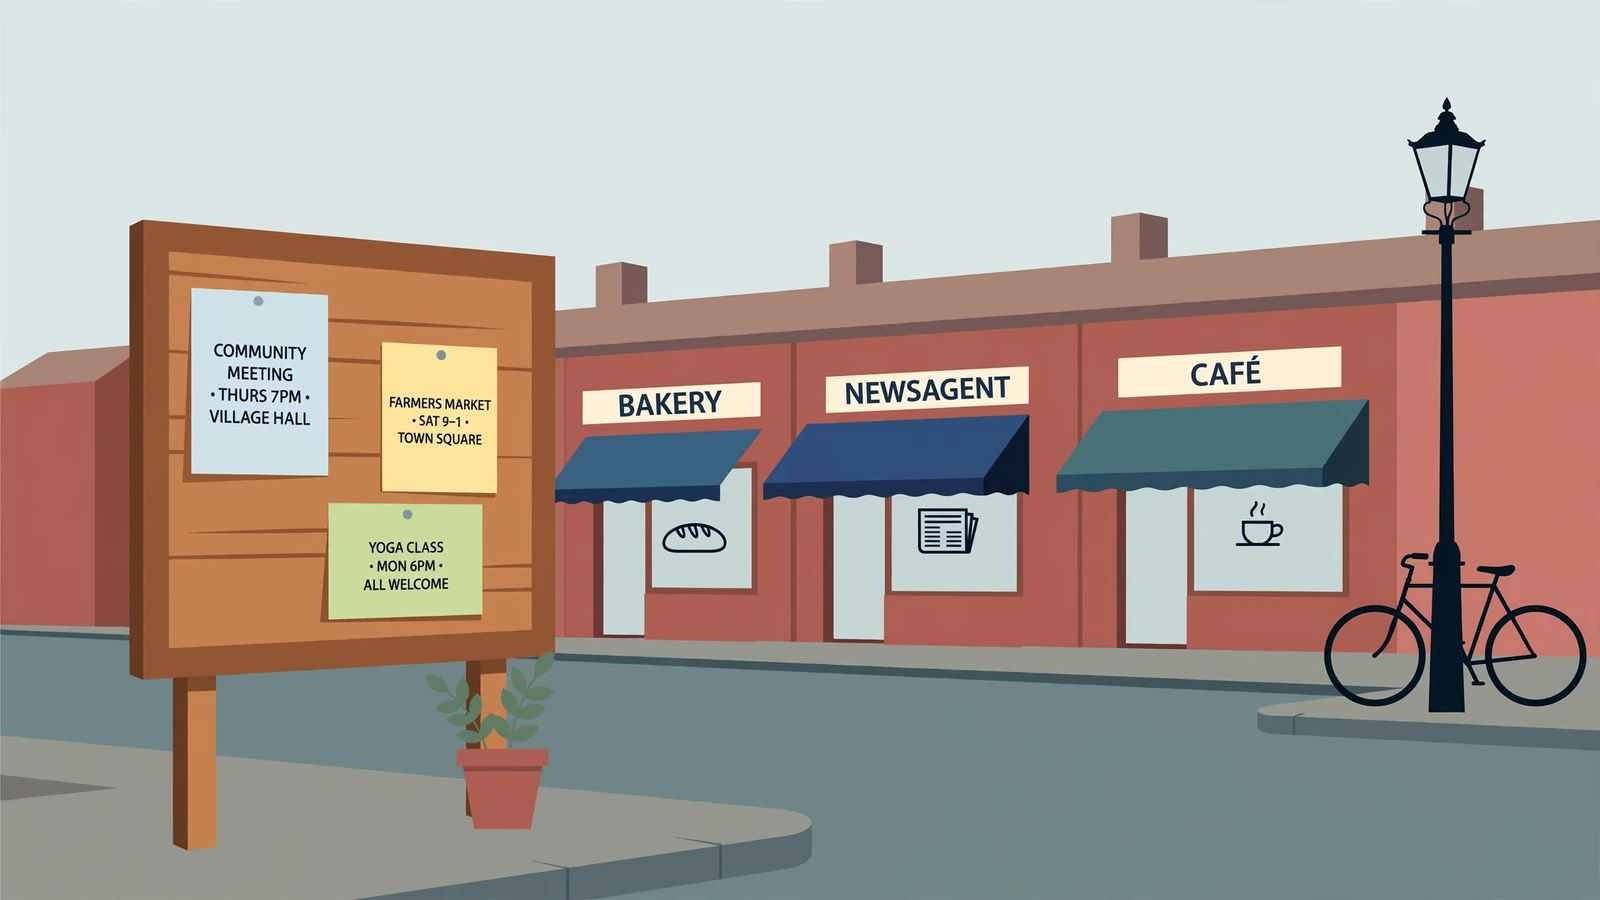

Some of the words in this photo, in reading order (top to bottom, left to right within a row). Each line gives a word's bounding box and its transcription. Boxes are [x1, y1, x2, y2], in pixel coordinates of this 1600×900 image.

[213, 343, 307, 361] COMMUNITY
[227, 365, 293, 382] MEETING
[1190, 354, 1261, 387] CAFÉ
[218, 387, 268, 403] THURS
[270, 388, 302, 404] 7PM
[845, 375, 1011, 405] NEWSAGENT
[389, 396, 443, 410] FARMERS
[444, 398, 492, 411] MARKET
[619, 390, 722, 418] BAKERY
[209, 409, 270, 425] VILLAGE
[273, 411, 311, 426] HALL
[419, 414, 440, 427] SAT
[397, 431, 434, 444] TOWN
[436, 432, 482, 447] SQUARE
[368, 541, 404, 554] YOGA
[406, 541, 444, 554] CLASS
[376, 560, 407, 573] MON
[409, 559, 436, 572] 6PM
[363, 578, 386, 591] ALL
[388, 577, 449, 591] WELCOME
